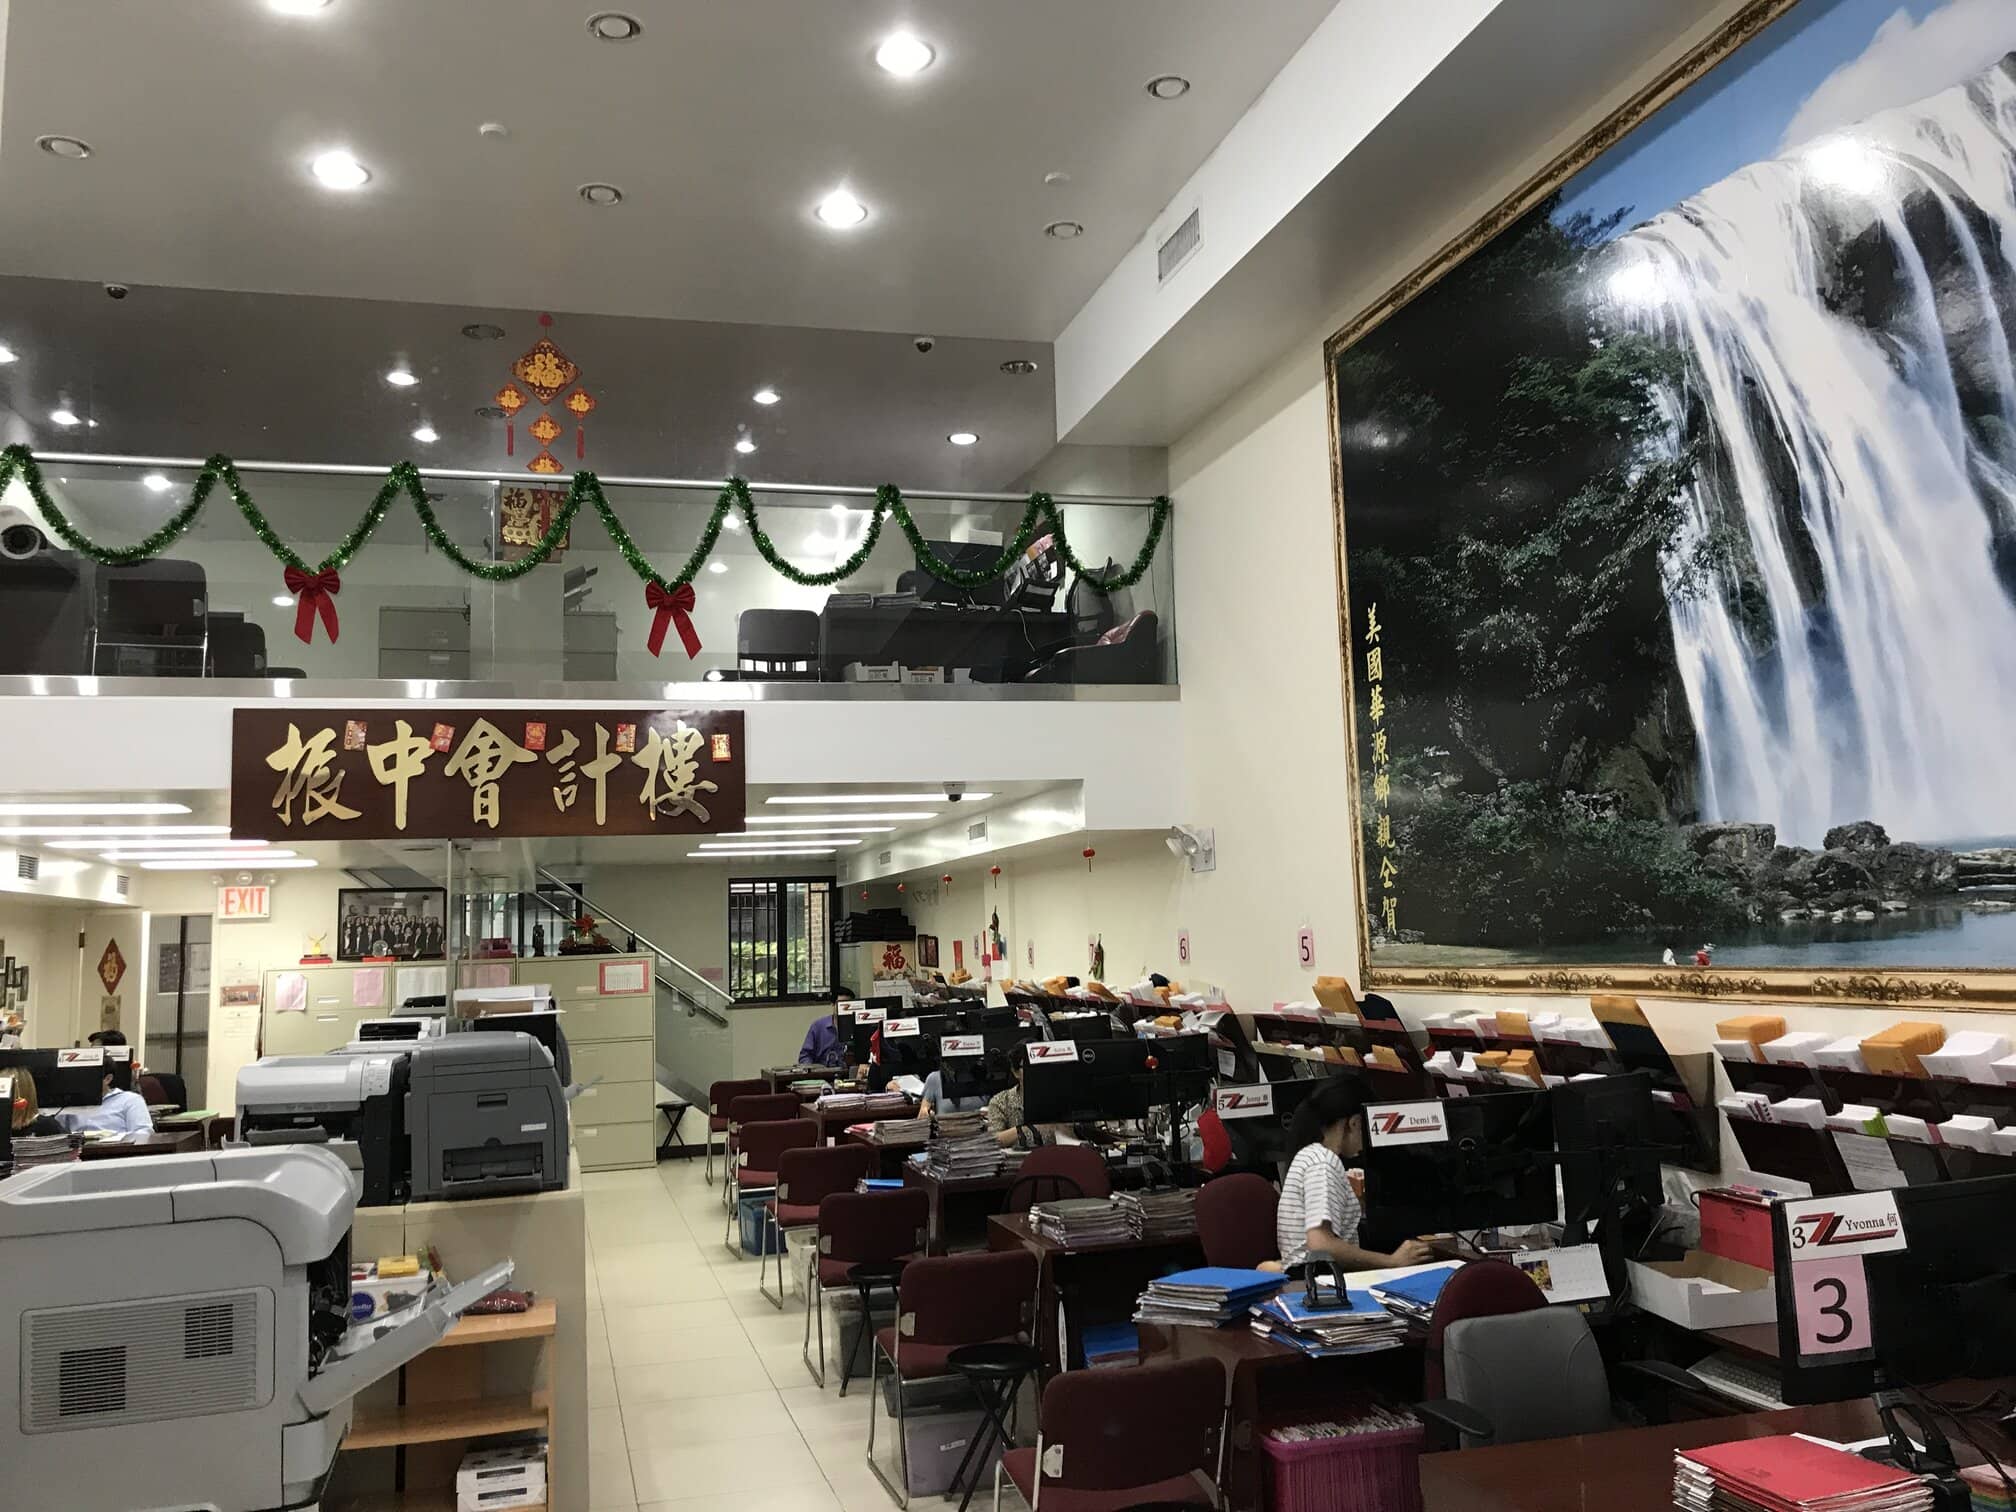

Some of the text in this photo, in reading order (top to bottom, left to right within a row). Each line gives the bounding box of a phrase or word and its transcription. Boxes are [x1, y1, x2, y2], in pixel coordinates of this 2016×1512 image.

[503, 487, 526, 510] 福
[265, 716, 719, 829] 振中會計樓
[223, 887, 266, 915] EXIT
[883, 943, 905, 970] 福
[1179, 937, 1187, 960] 6
[1301, 936, 1311, 962] 5
[1217, 1099, 1225, 1111] 5
[1371, 1120, 1380, 1135] 4
[1409, 1114, 1430, 1126] Demi
[1792, 1226, 1806, 1249] 3
[1844, 1217, 1886, 1232] Yvonna
[1886, 1212, 1898, 1227] 何
[1812, 1277, 1853, 1344] 3
